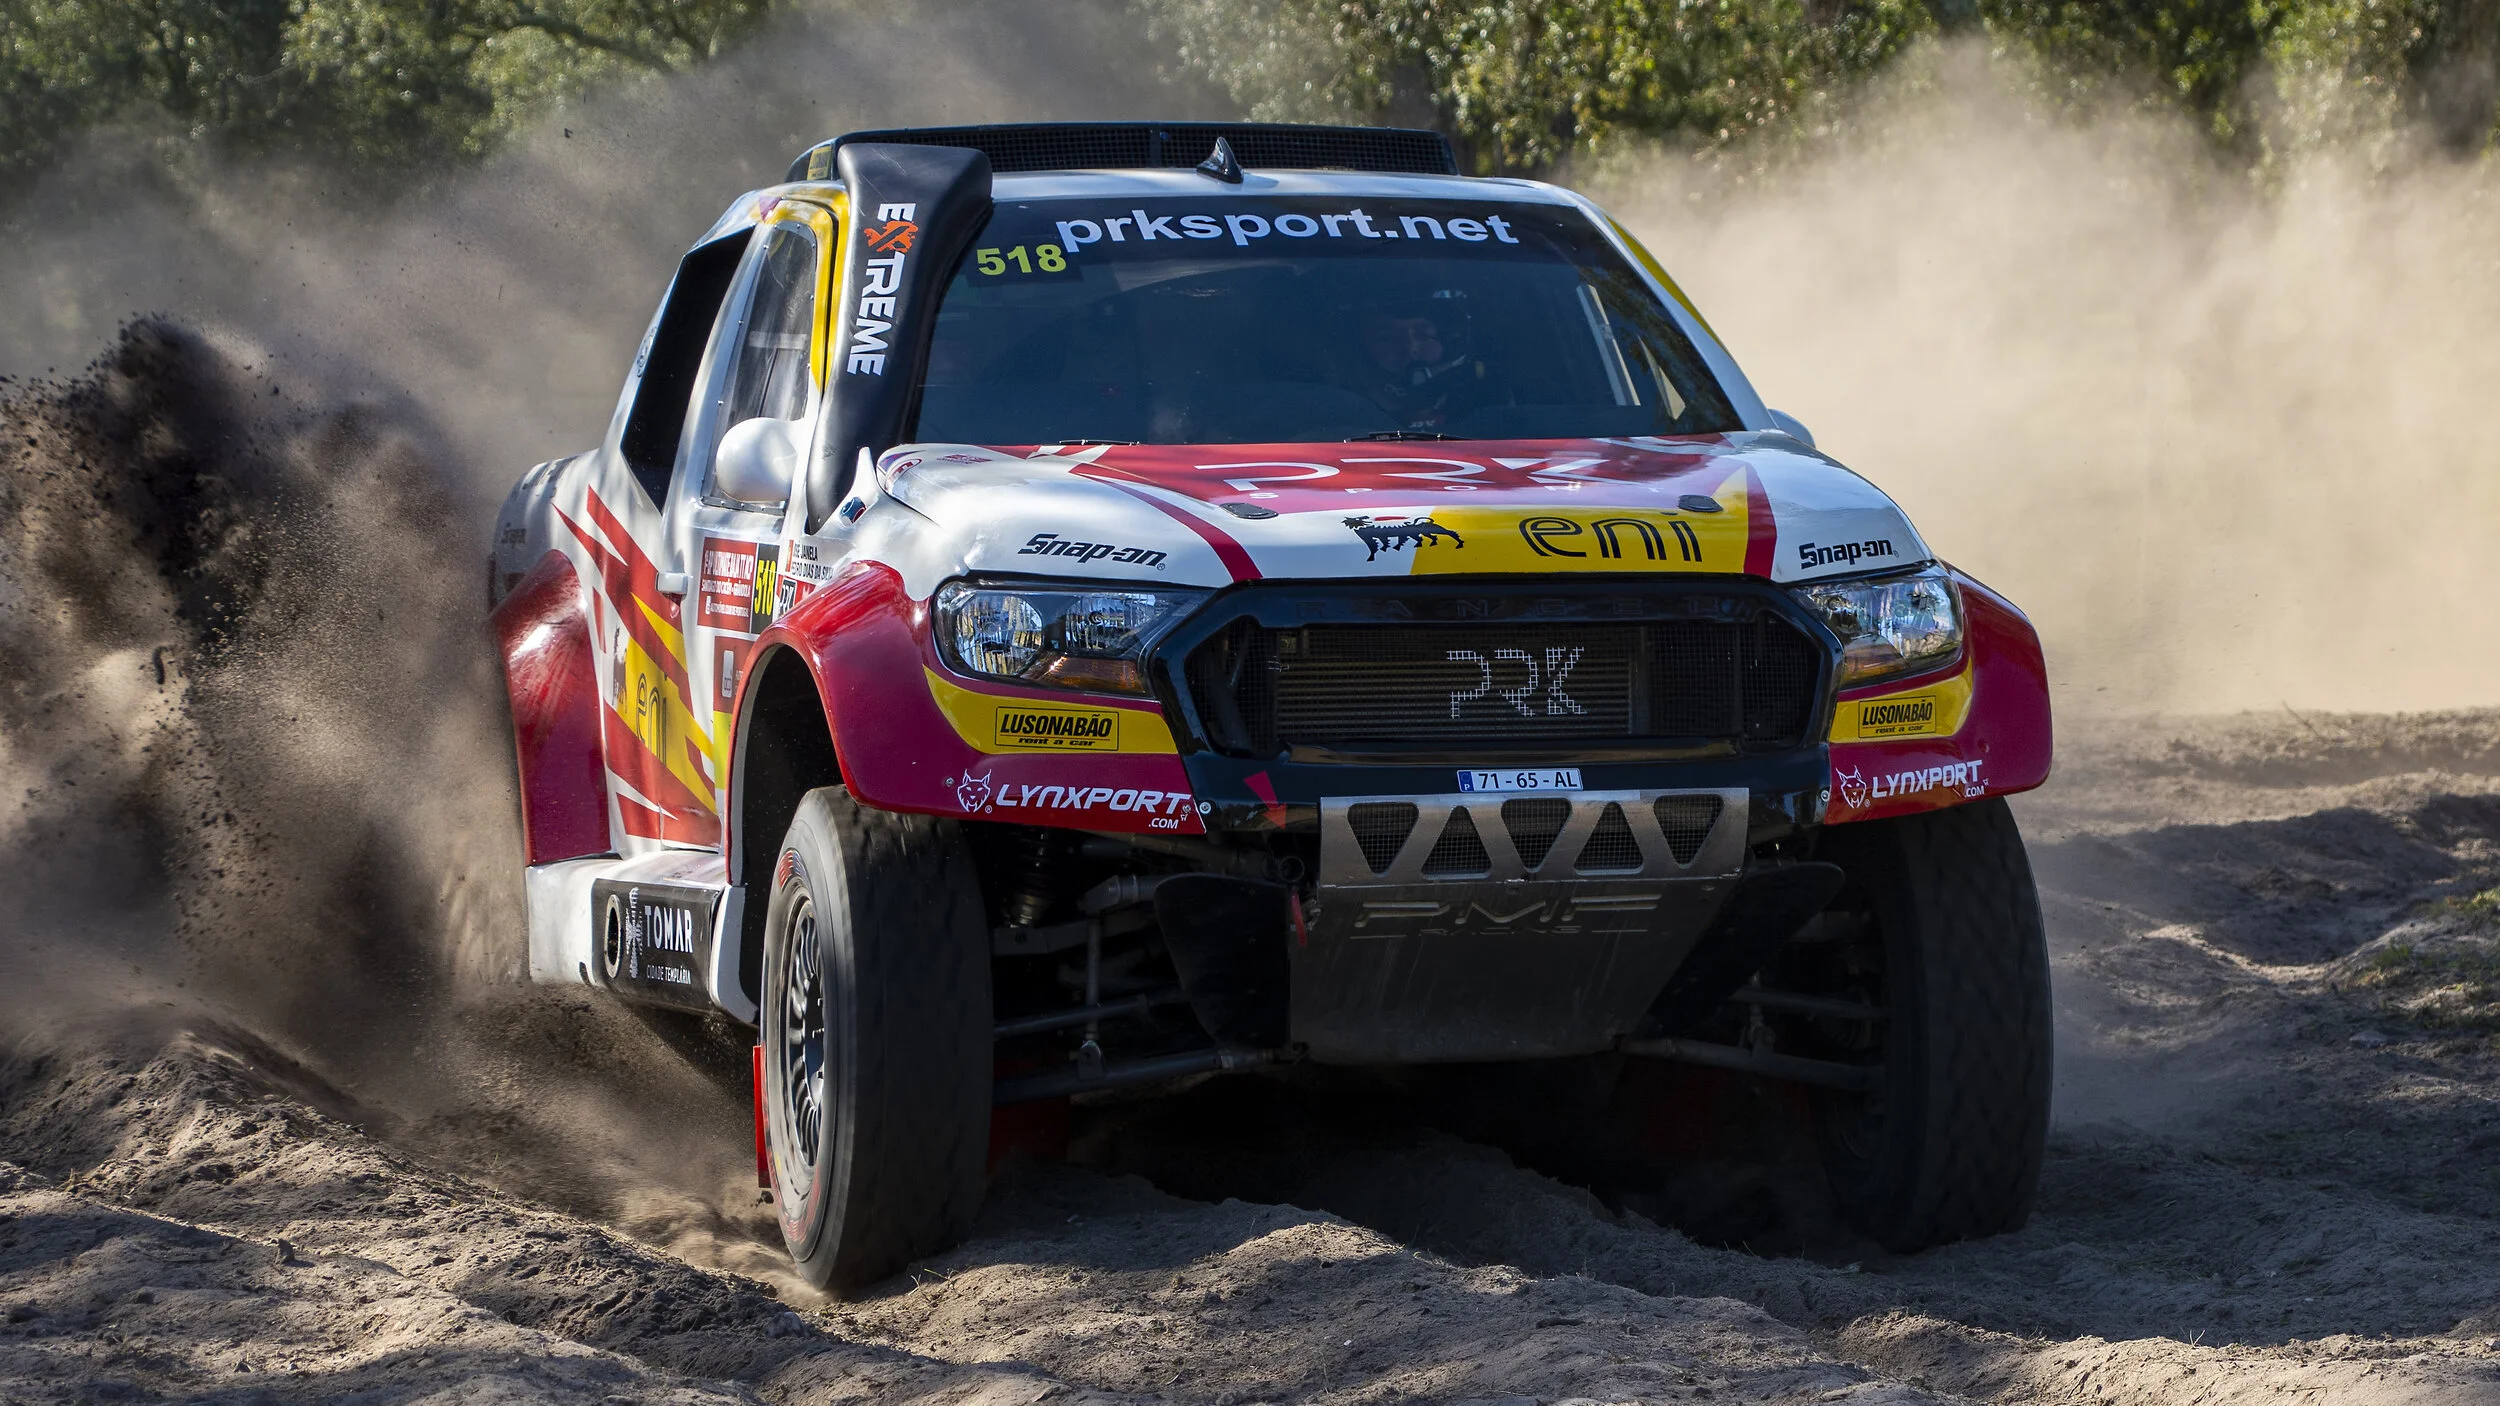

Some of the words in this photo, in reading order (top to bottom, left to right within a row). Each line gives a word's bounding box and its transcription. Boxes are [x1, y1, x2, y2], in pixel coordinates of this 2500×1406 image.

[1055, 209, 1520, 253] prksport.net
[976, 244, 1067, 275] 518
[847, 203, 919, 376] EXTREME
[1017, 533, 1168, 564] Snap-on
[1518, 511, 1703, 562] eni
[1798, 540, 1894, 569] Snap-on
[754, 559, 777, 616] 518
[1446, 647, 1588, 719] PRK
[636, 671, 667, 766] eni
[1000, 713, 1113, 738] LUSONABÃO
[1862, 700, 1933, 726] LUSONABÃO
[1875, 726, 1896, 734] rent
[1464, 783, 1470, 791] P
[1871, 759, 1983, 799] LYNXPORT
[995, 783, 1192, 815] LYNXPORT
[1148, 816, 1179, 830] .COM
[644, 905, 693, 954] TOMAR
